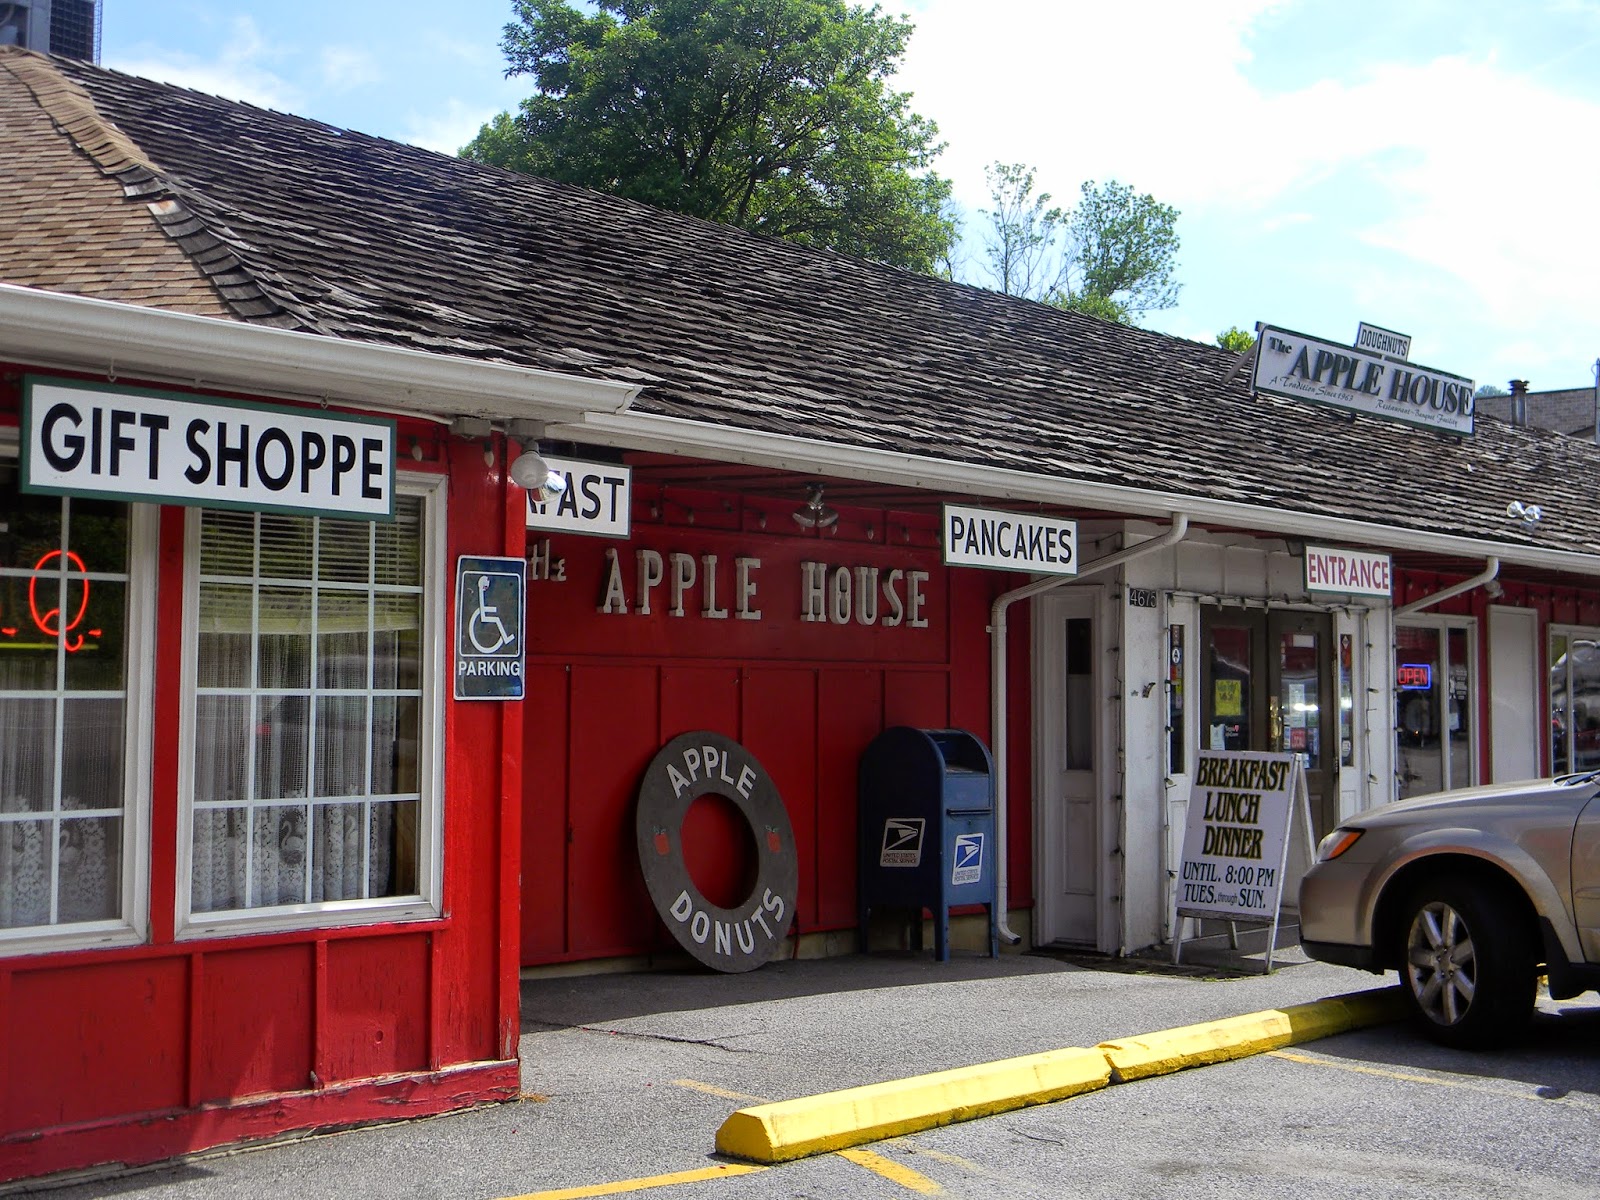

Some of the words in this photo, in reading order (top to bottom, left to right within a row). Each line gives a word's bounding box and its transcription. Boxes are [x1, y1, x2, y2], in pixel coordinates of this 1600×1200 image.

[1360, 329, 1407, 357] DOUGHNUTS
[1269, 337, 1292, 355] The
[1290, 344, 1385, 396] APPLE
[1389, 368, 1473, 417] HOUSE
[1269, 376, 1277, 385] A
[1280, 376, 1316, 393] Tradition
[42, 402, 169, 480] GIFT
[184, 418, 382, 499] SHOPPE
[951, 515, 1072, 564] PANCAKES
[597, 548, 762, 620] APPLE
[801, 561, 929, 628] HOUSE
[1309, 553, 1389, 590] ENTRANCE
[458, 661, 520, 676] PARKING
[1398, 667, 1427, 685] OPEN
[666, 745, 756, 799] APPLE
[1195, 757, 1290, 791] BREAKFAST
[1203, 791, 1261, 824] LUNCH
[1201, 825, 1264, 859] DINNER
[1225, 865, 1253, 885] 8:00
[1256, 868, 1275, 887] PM
[1184, 884, 1217, 904] TUES.
[1217, 891, 1238, 906] through
[1238, 889, 1266, 909] SUN.
[670, 888, 784, 955] DONUTS
